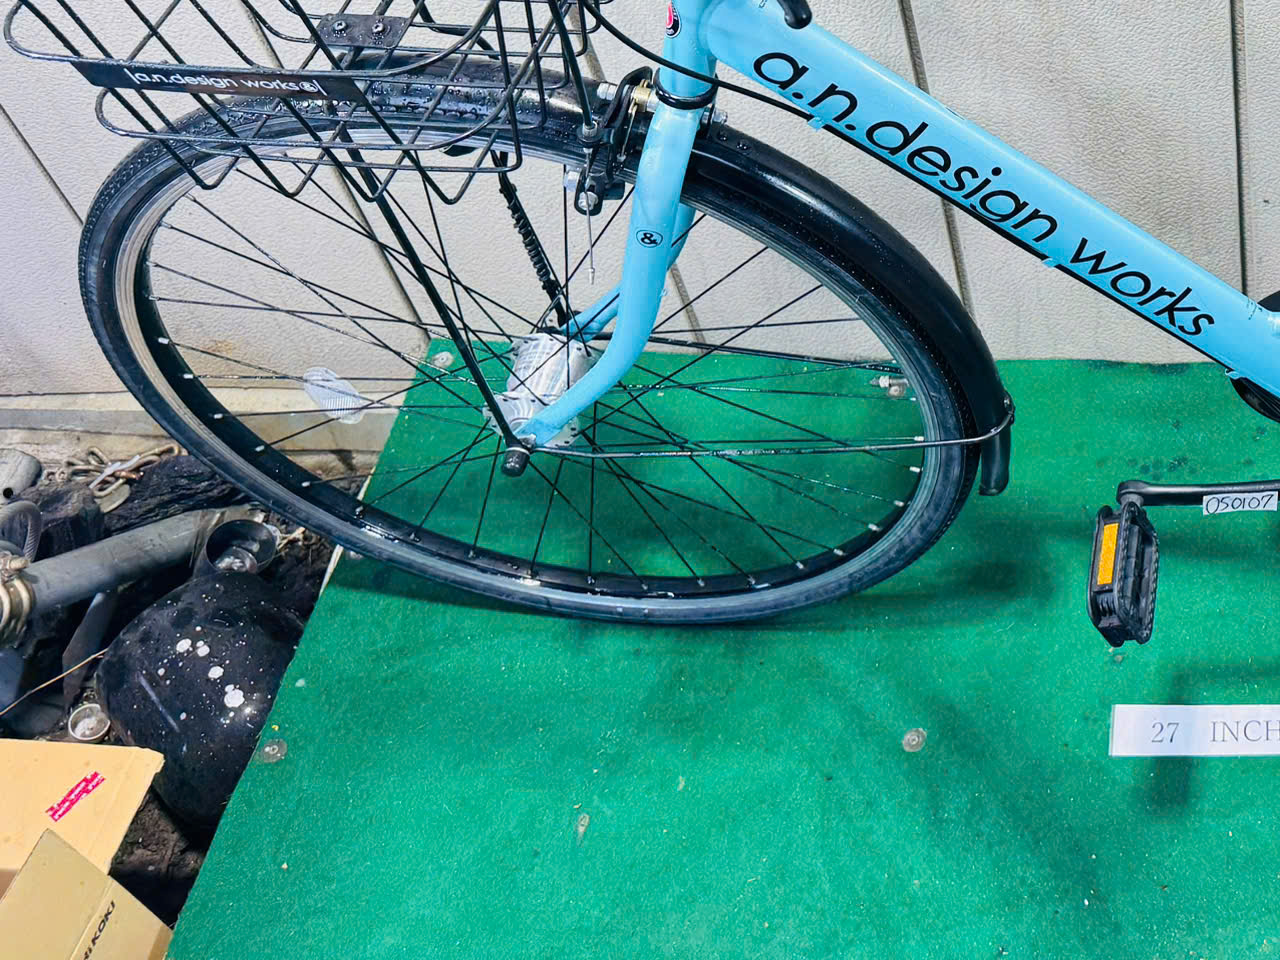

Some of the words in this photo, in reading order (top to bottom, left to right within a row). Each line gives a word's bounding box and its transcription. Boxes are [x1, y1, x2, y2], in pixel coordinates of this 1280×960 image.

[753, 51, 1058, 244] a.n.design
[1069, 237, 1215, 337] works
[1150, 722, 1180, 743] 27
